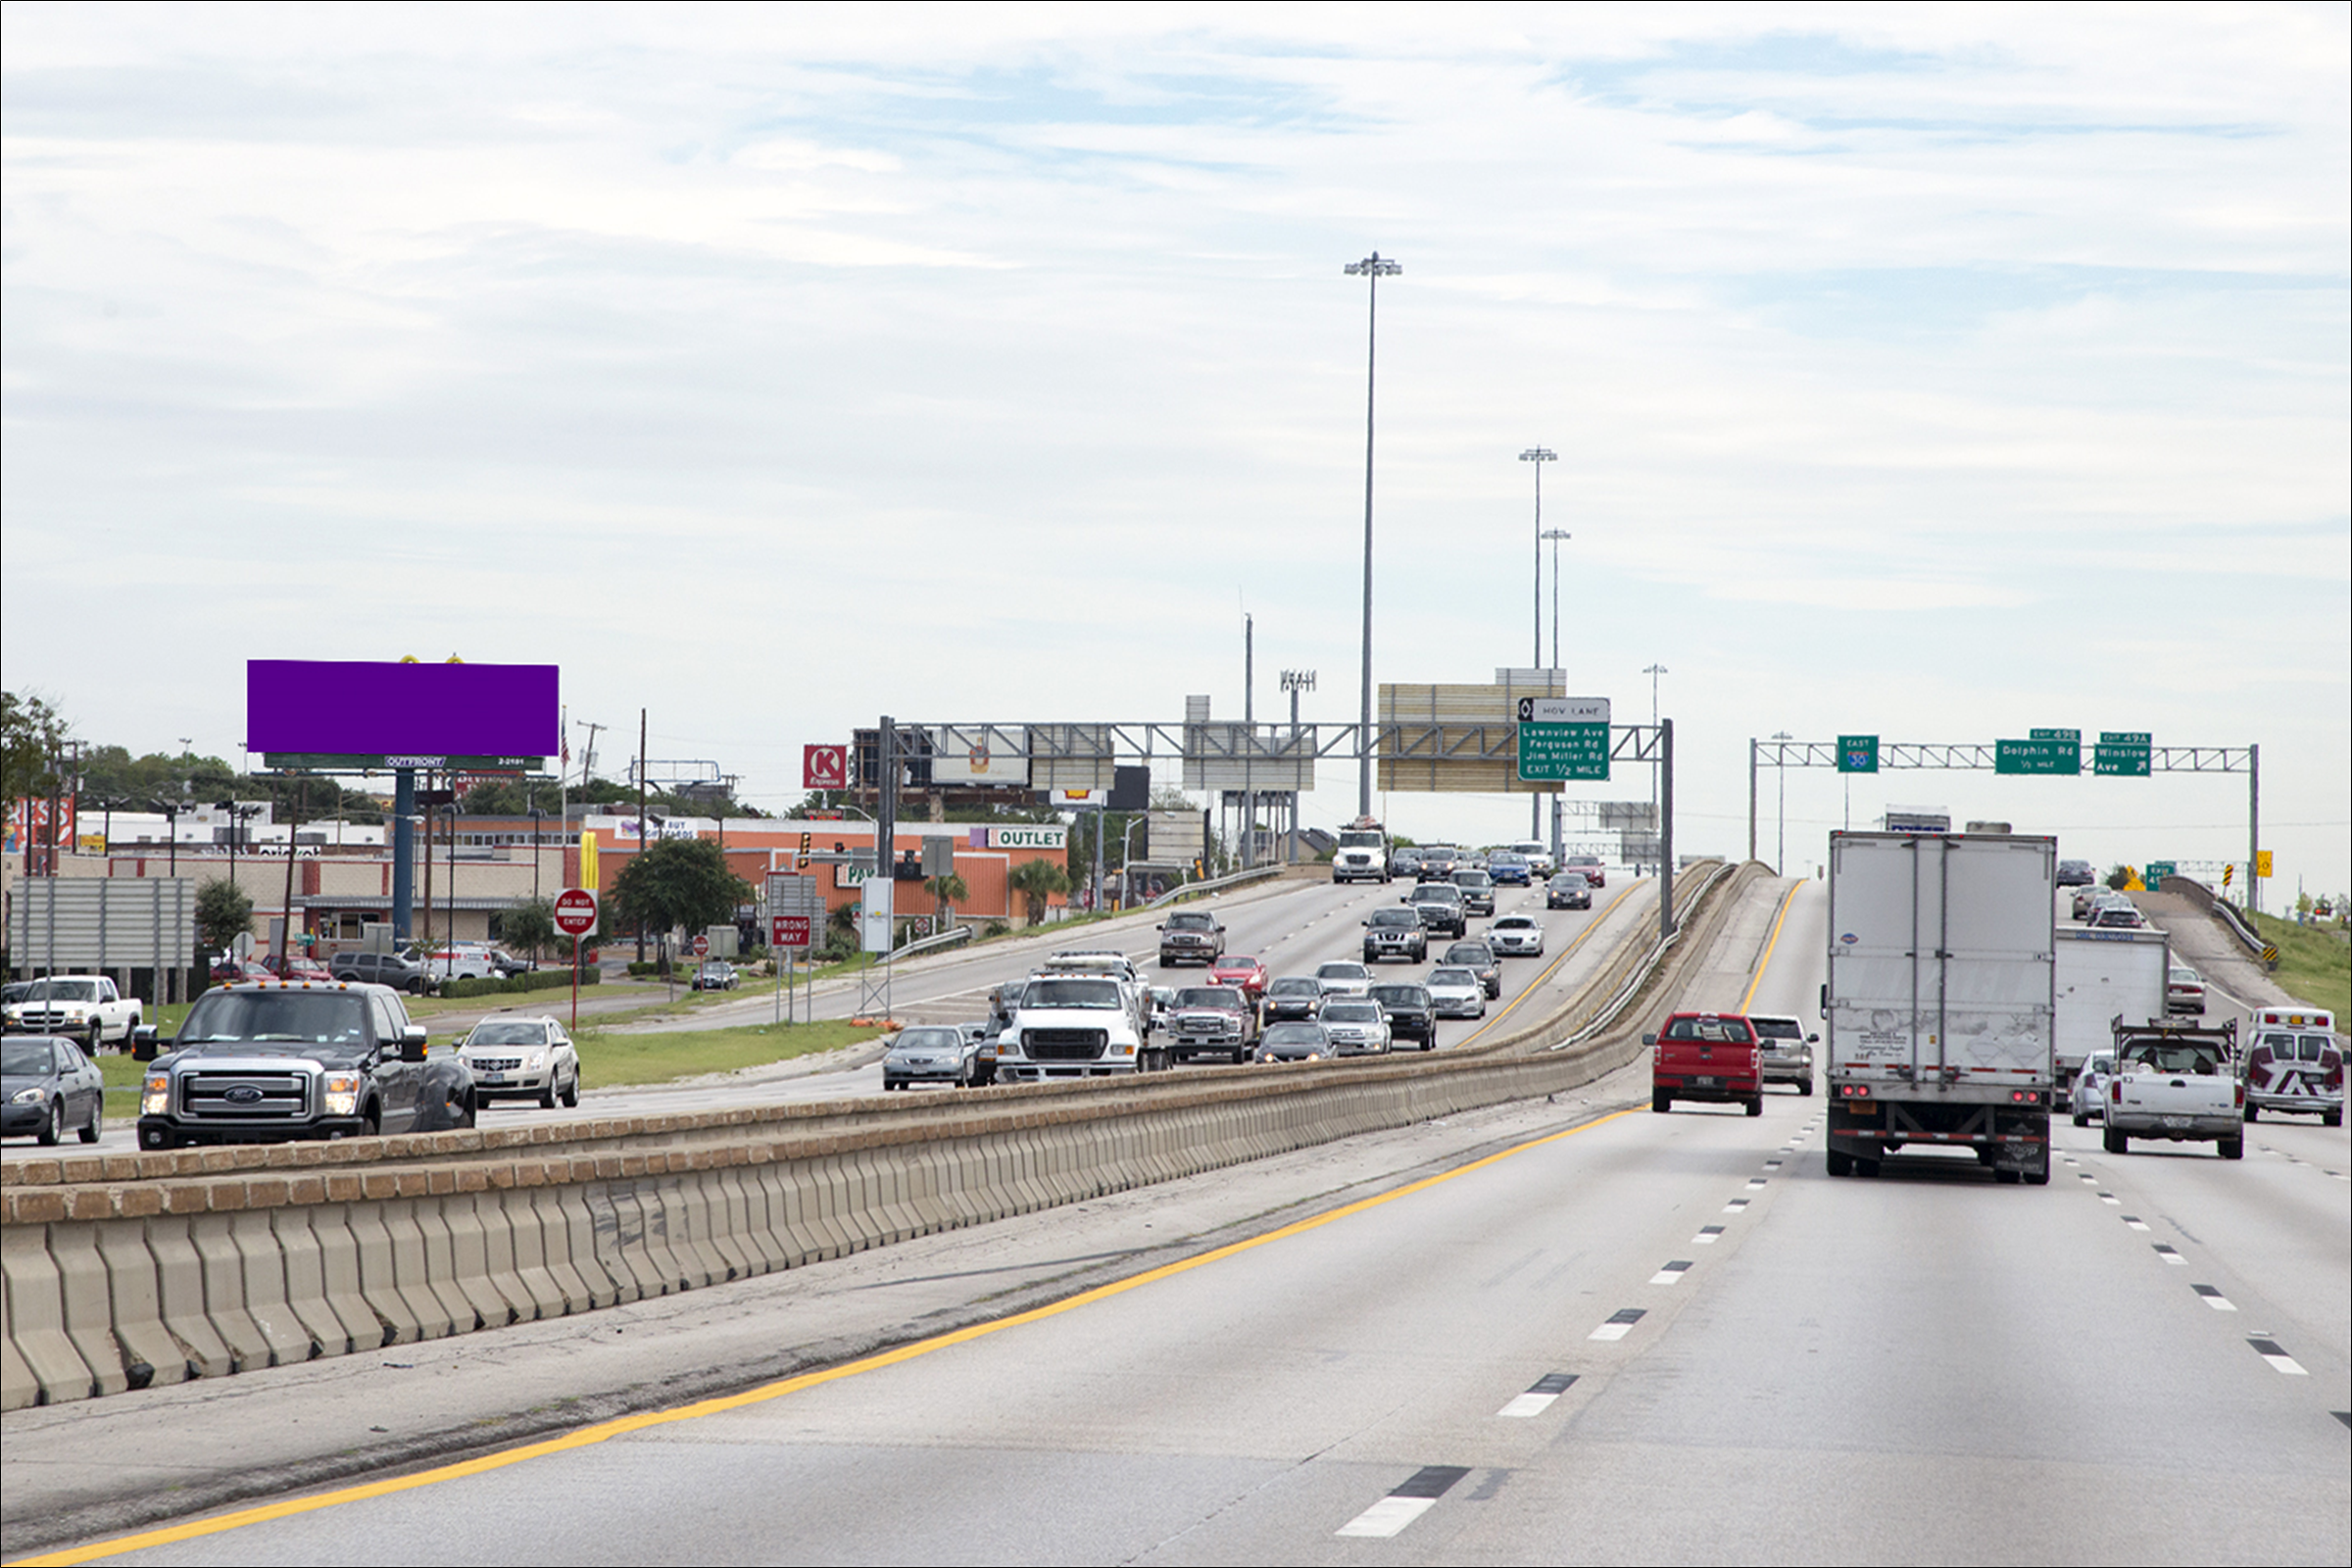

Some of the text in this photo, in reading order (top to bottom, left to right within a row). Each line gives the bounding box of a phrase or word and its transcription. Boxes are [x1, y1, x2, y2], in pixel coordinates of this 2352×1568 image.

[1571, 707, 1599, 715] LANE
[1522, 727, 1604, 737] Lawnview Ave
[1846, 739, 1869, 748] EAST
[2124, 734, 2148, 743] 49A
[1529, 740, 1599, 751] Ferguson Rd
[1526, 752, 1603, 760] Jim Miller Rd
[2002, 746, 2074, 757] Dolphin Rd
[2097, 748, 2148, 758] Winslow
[385, 756, 445, 767] OUTFRONT
[815, 749, 840, 777] K
[1851, 754, 1866, 766] 30
[1527, 764, 1550, 774] EXIT
[1576, 765, 1601, 774] MILE
[2096, 762, 2119, 771] Ave
[809, 776, 840, 787] Express
[1000, 831, 1063, 846] OUTLET
[562, 898, 590, 906] DO NOT
[564, 917, 587, 926] ENTER
[774, 919, 808, 930] WRONG
[780, 932, 802, 943] WAY
